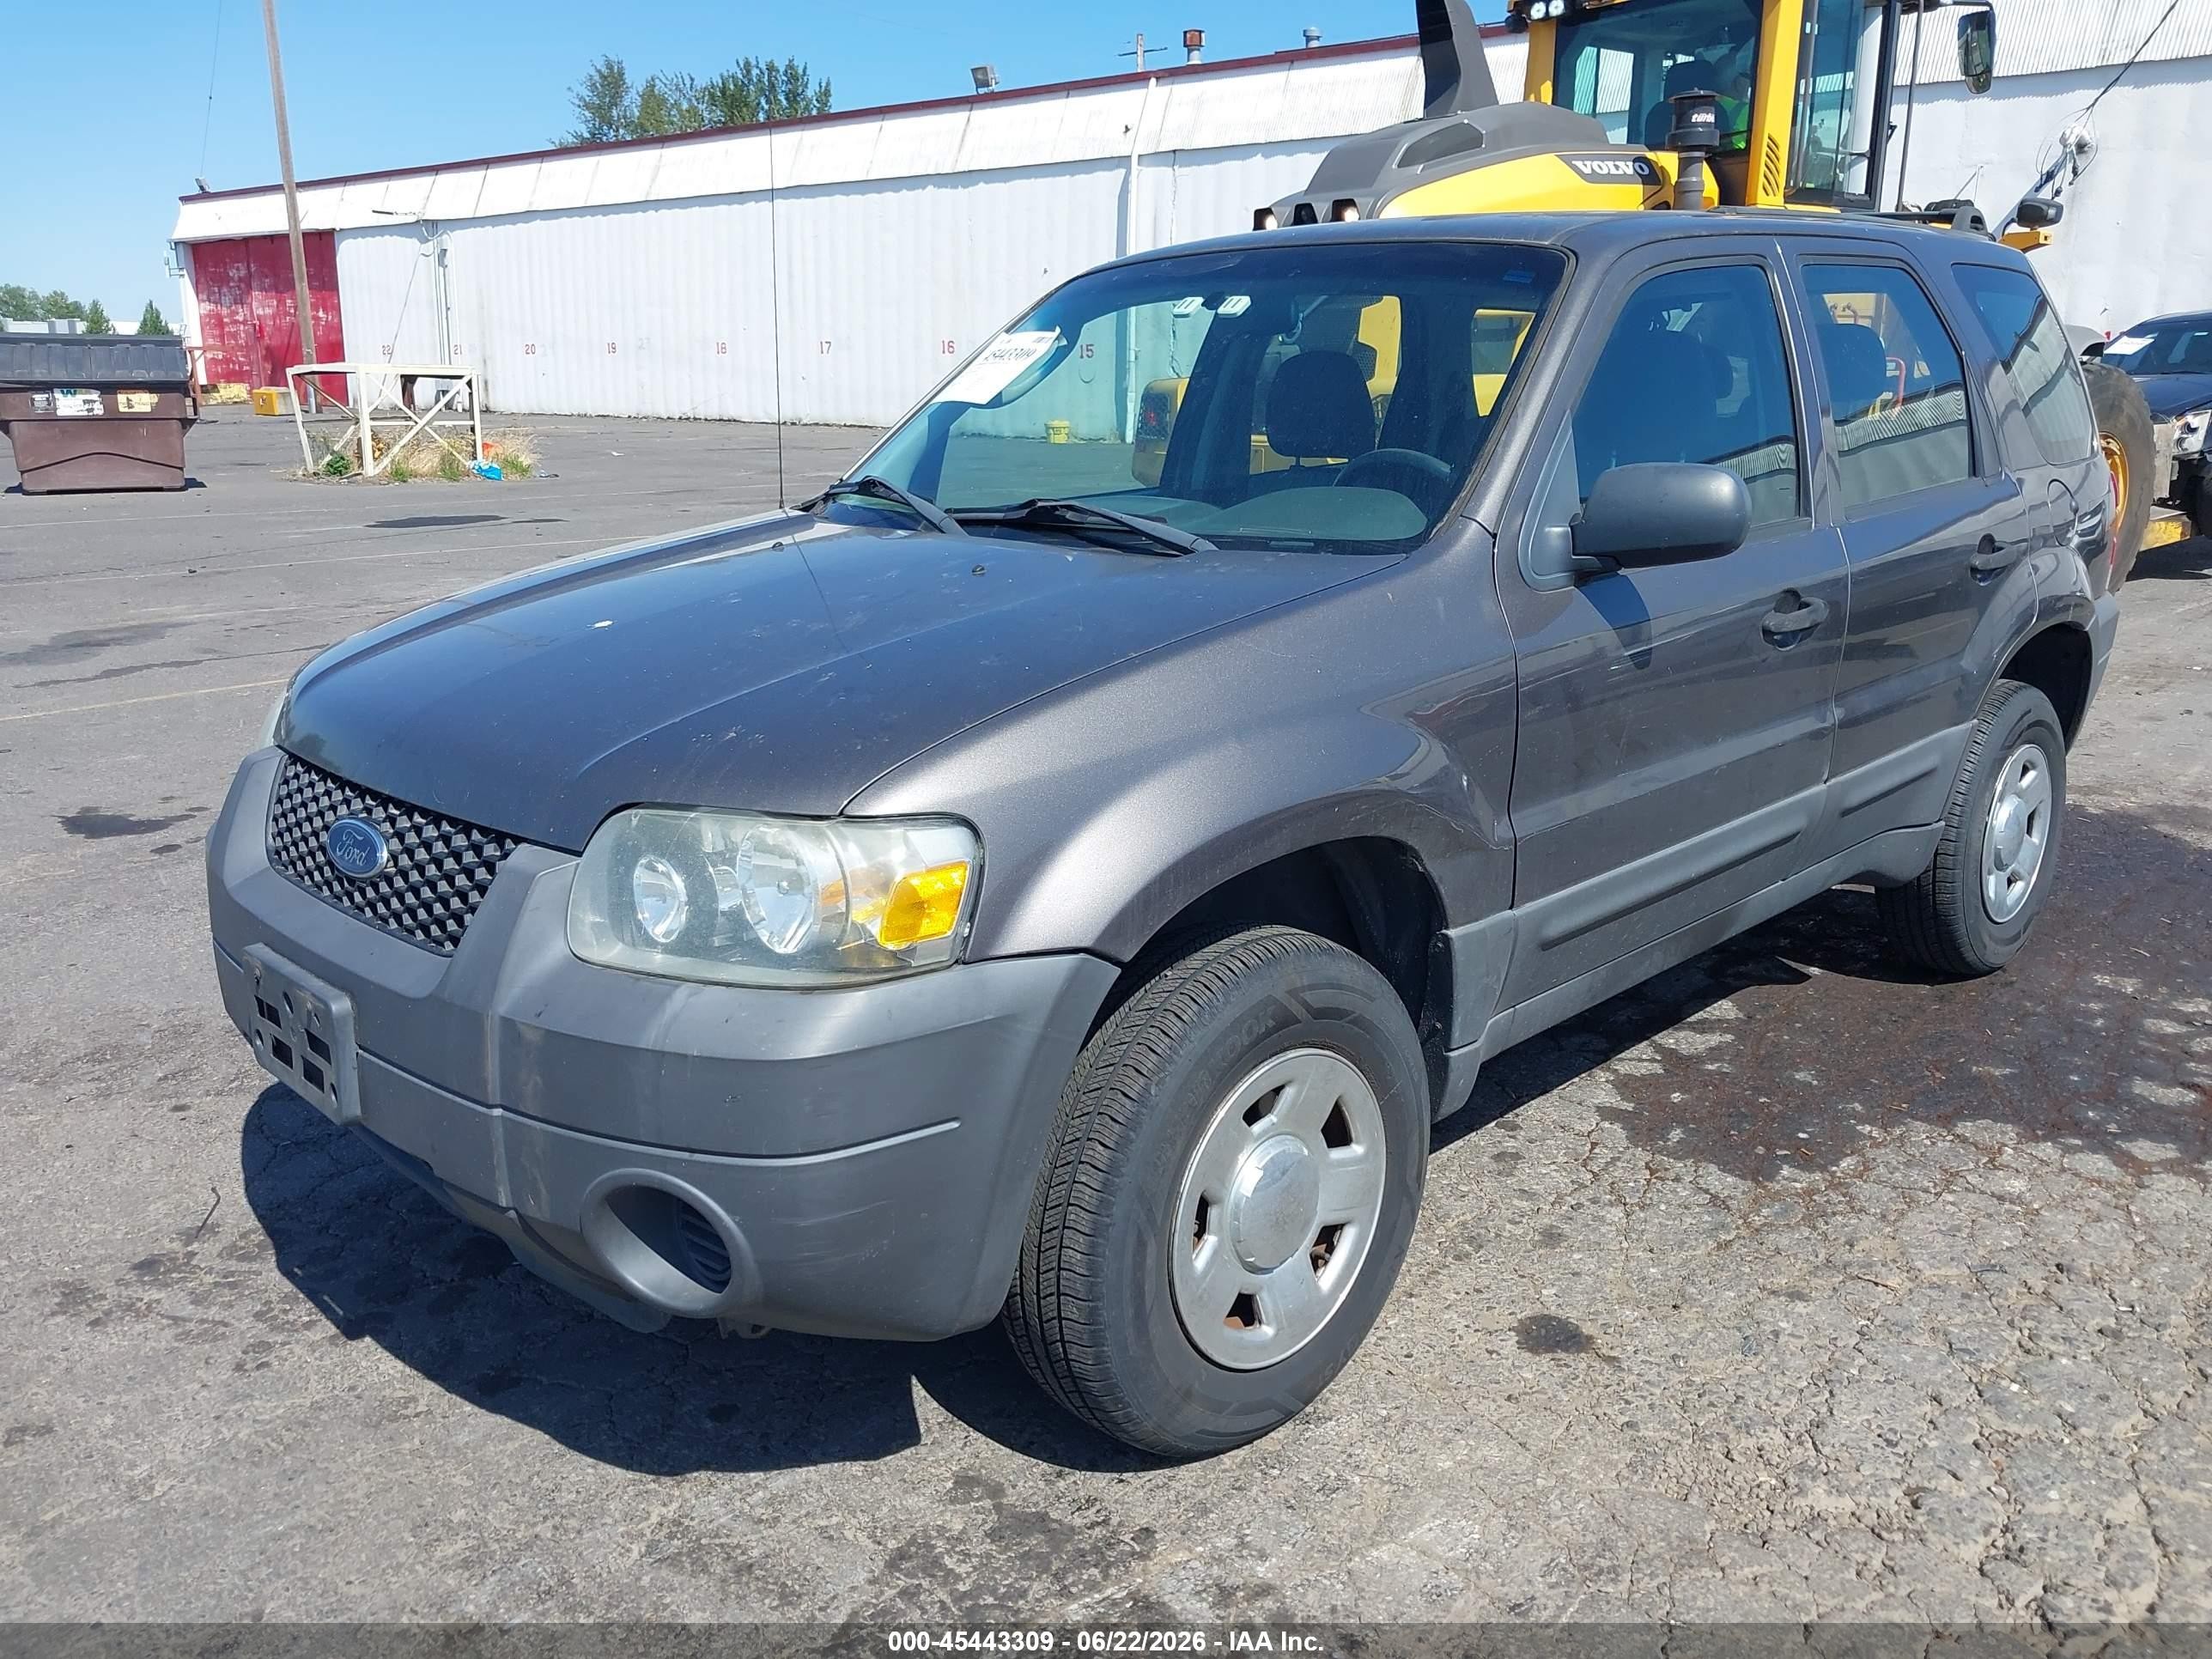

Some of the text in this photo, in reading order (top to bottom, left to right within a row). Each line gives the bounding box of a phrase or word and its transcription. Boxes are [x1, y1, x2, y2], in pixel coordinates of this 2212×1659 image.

[1571, 161, 1650, 175] VOLVO
[382, 344, 392, 356] 22
[453, 343, 463, 356] 21
[525, 343, 536, 355] 20
[607, 342, 617, 354] 19
[716, 342, 727, 355] 18
[819, 341, 831, 354] 17
[942, 340, 955, 354] 16
[1079, 344, 1094, 358] 15
[336, 829, 368, 866] Ford
